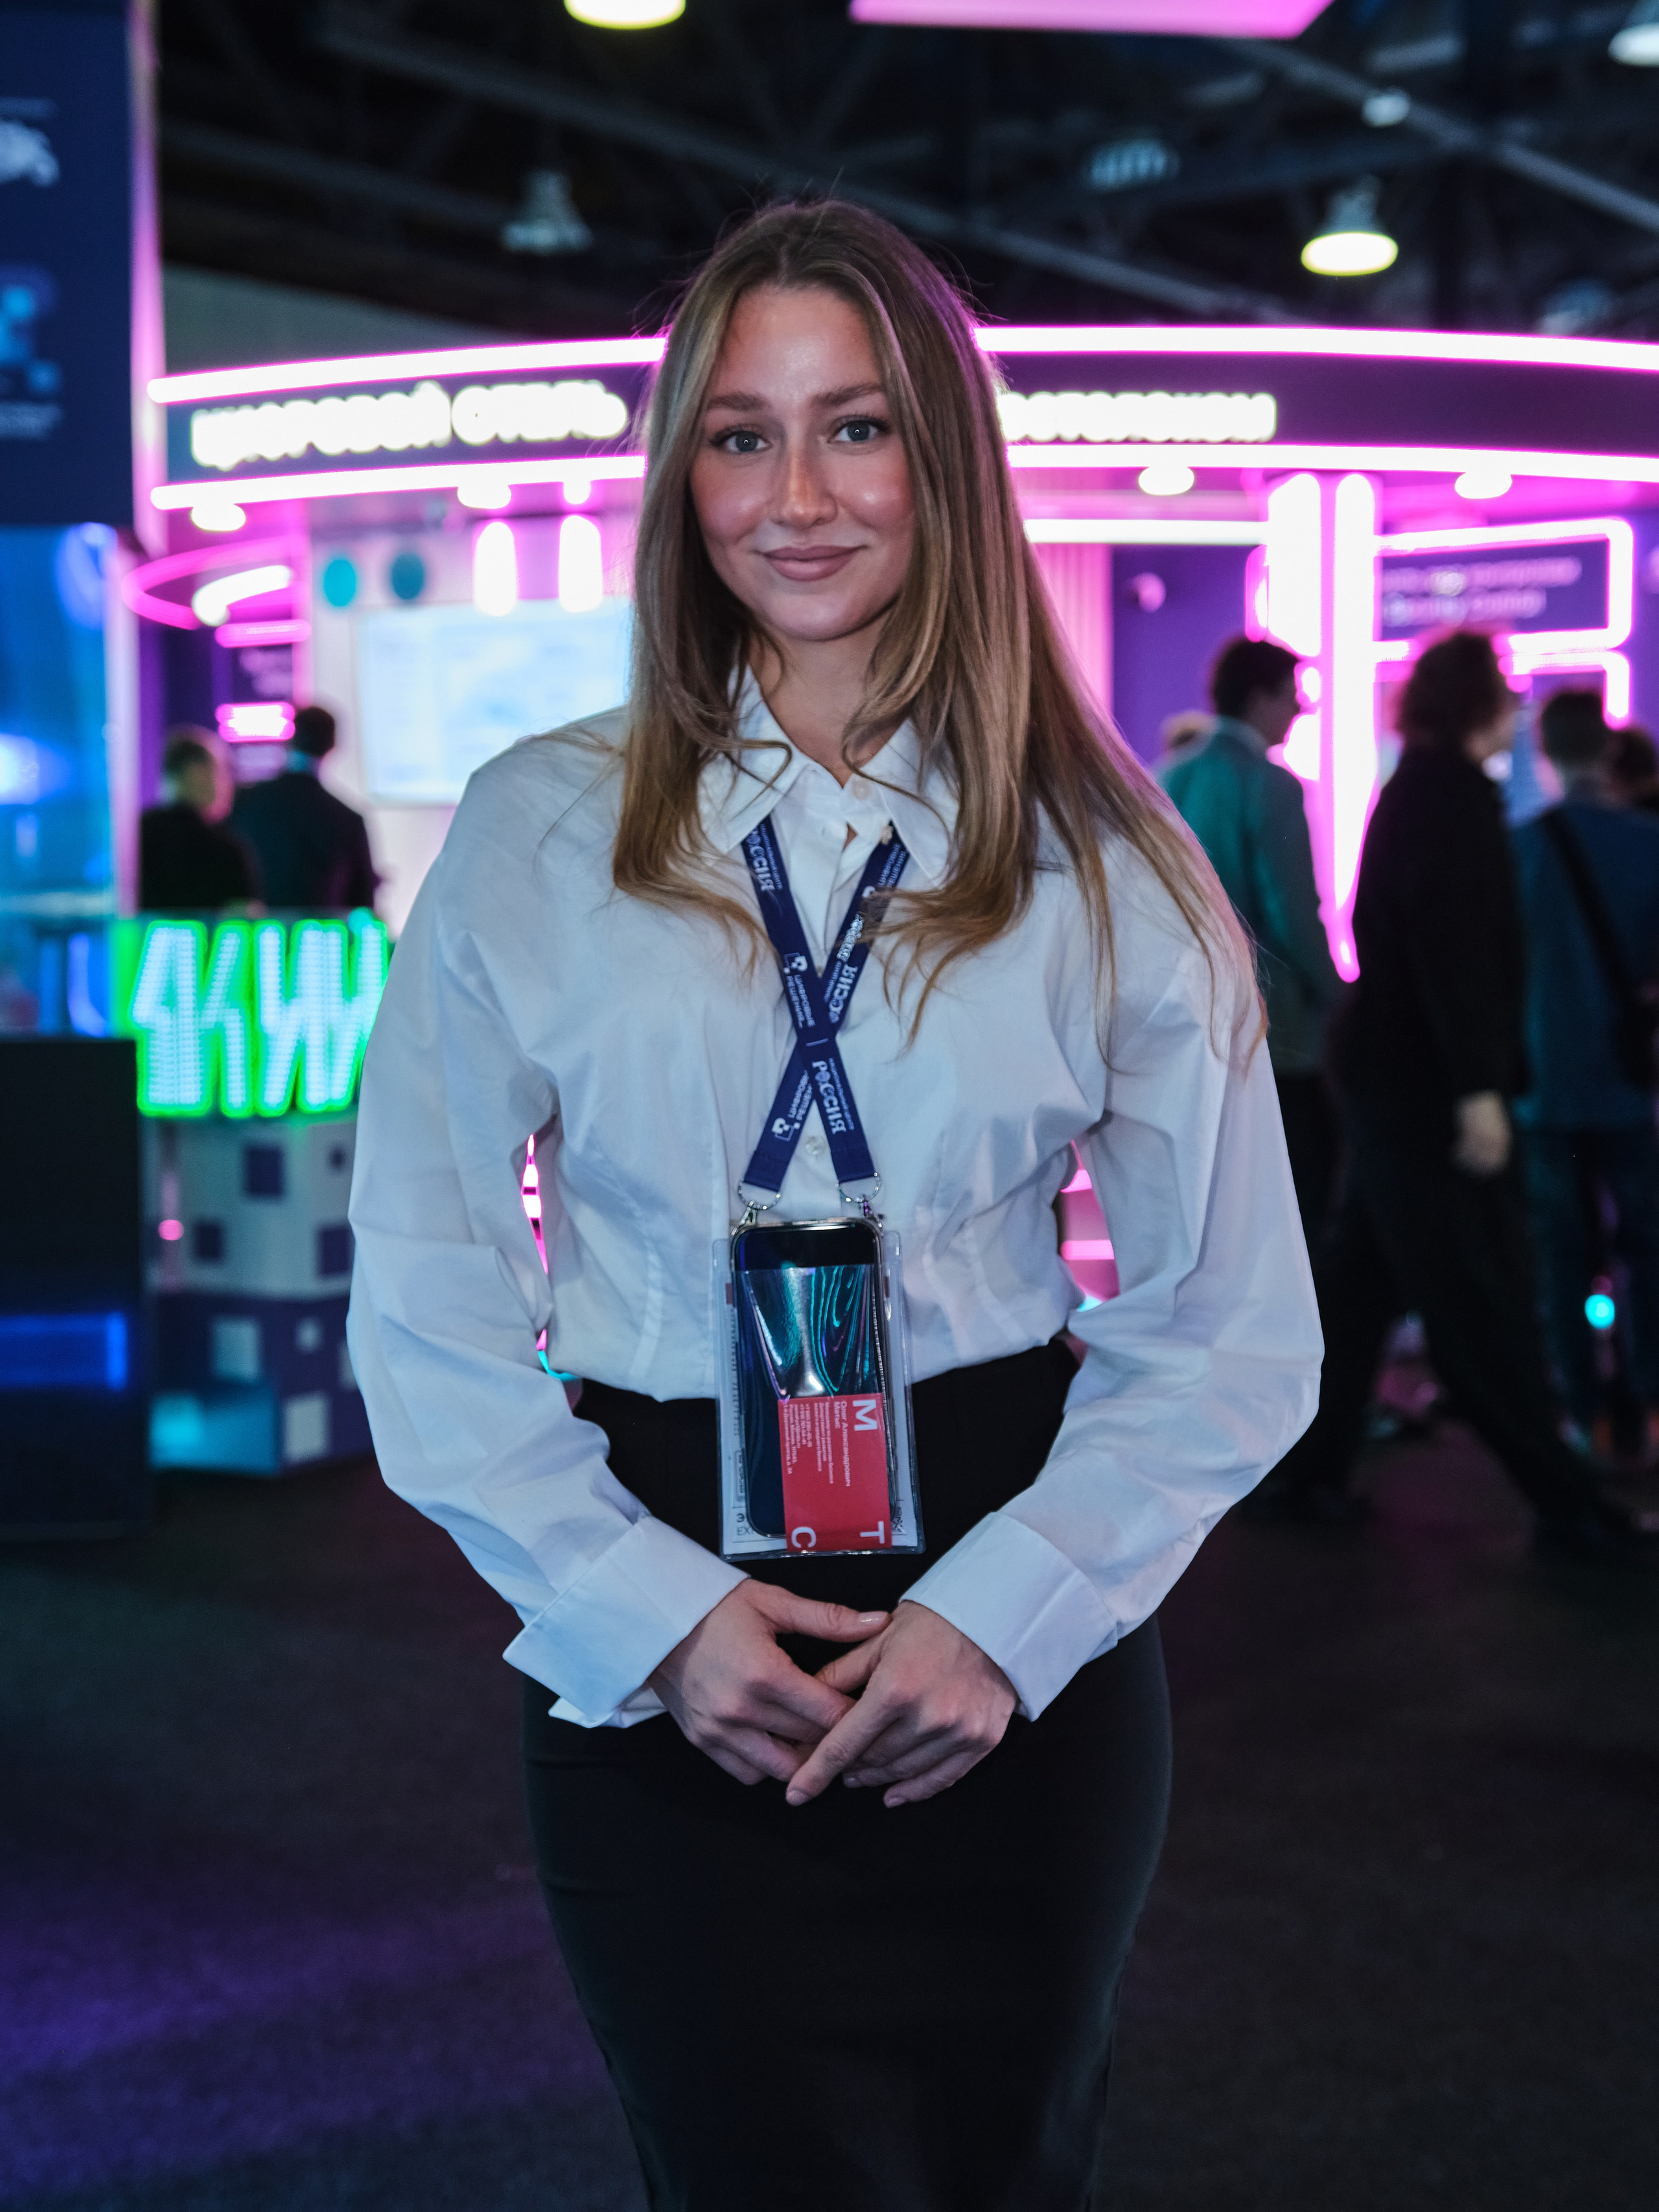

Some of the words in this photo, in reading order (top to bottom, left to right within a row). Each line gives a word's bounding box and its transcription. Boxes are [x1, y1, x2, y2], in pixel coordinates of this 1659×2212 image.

[793, 973, 816, 1027] ЦИФРОВЫЕ
[828, 963, 858, 1022] ОССИЯ
[811, 1059, 847, 1135] РОССИЯ
[841, 1422, 852, 1486] Александрович
